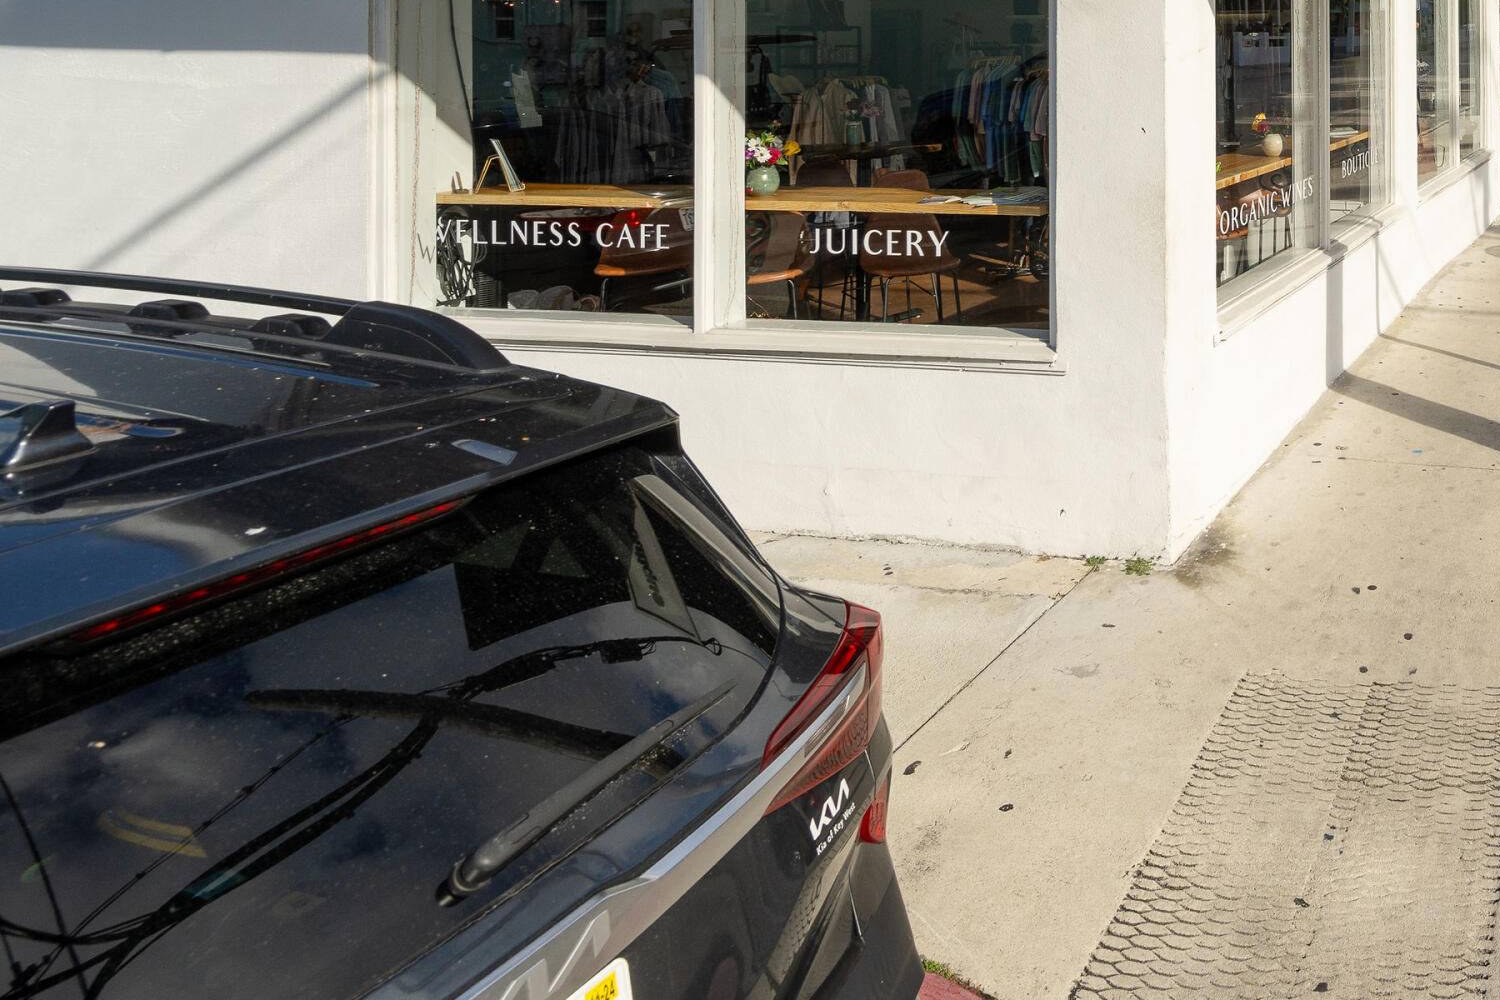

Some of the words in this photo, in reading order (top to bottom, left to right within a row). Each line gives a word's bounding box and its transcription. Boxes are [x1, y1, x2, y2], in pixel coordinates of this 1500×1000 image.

[1219, 190, 1278, 235] ORGANIC
[1280, 176, 1313, 209] WINES
[595, 222, 671, 250] CAFE
[809, 227, 950, 257] JUICERY
[816, 840, 828, 856] Kia
[828, 830, 834, 843] of
[833, 820, 844, 836] Key
[842, 802, 856, 821] West
